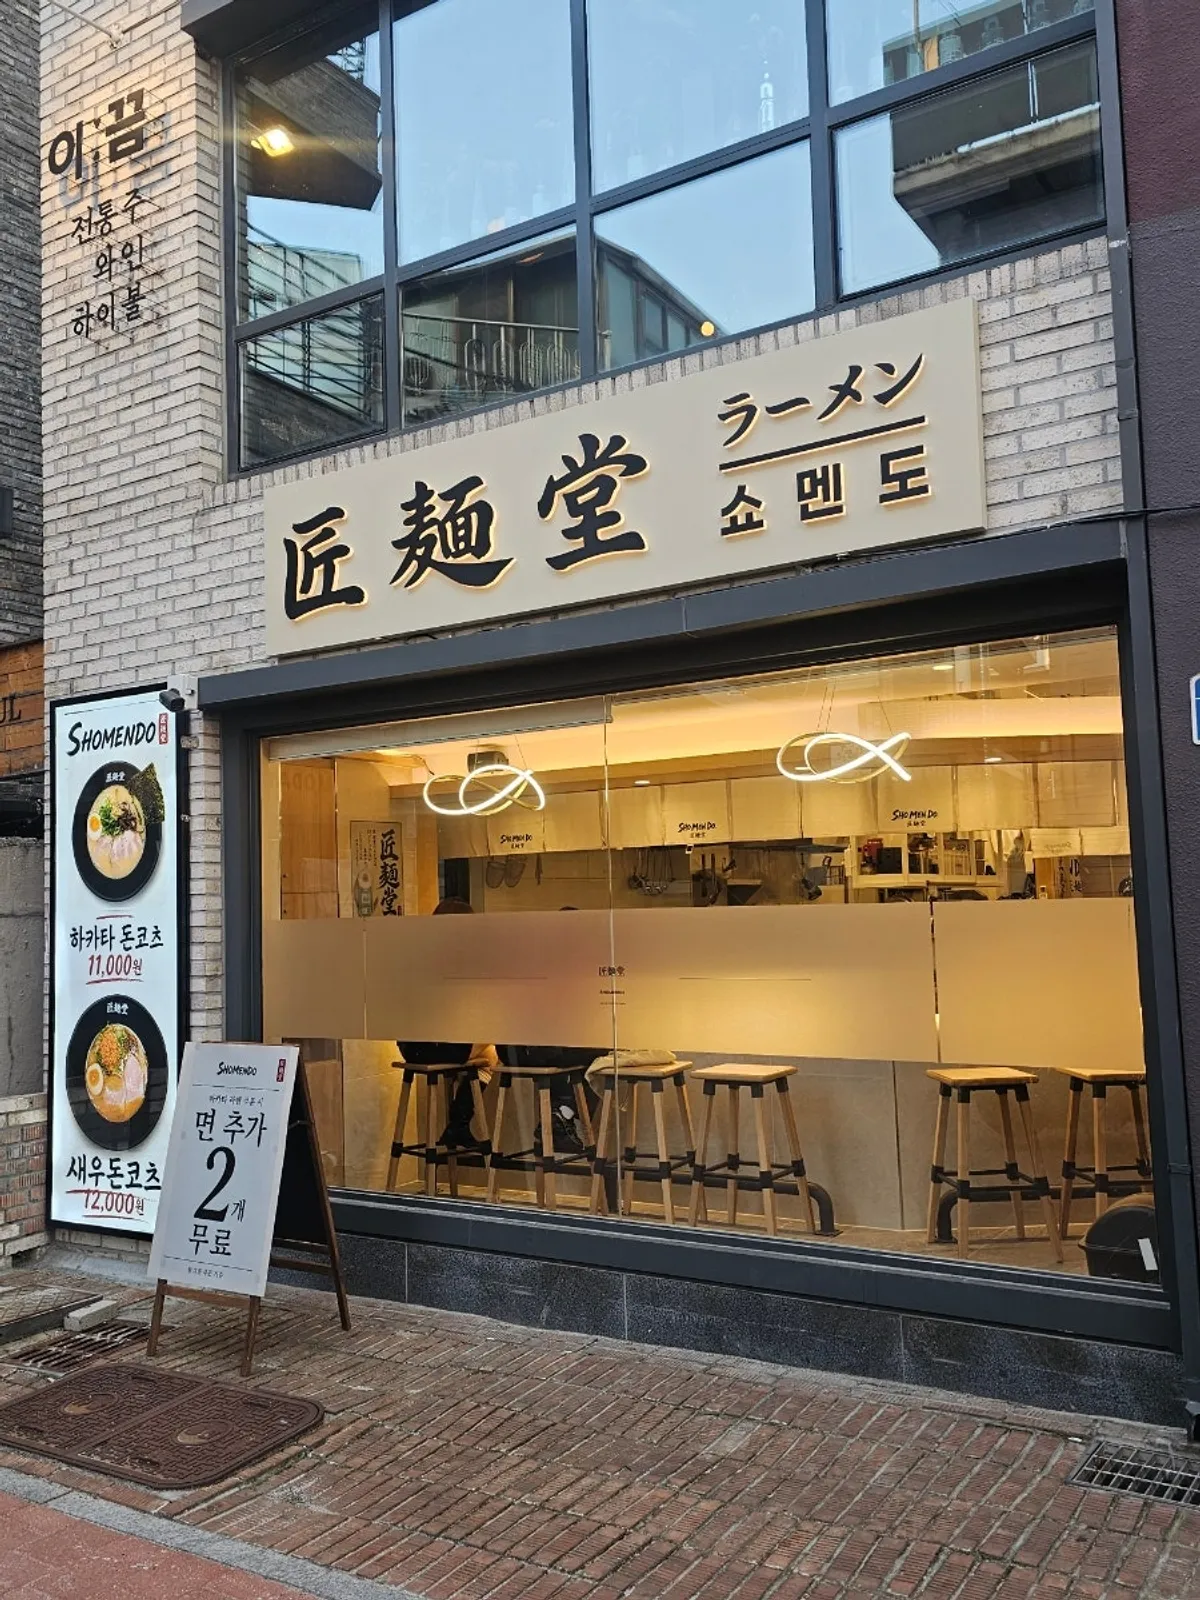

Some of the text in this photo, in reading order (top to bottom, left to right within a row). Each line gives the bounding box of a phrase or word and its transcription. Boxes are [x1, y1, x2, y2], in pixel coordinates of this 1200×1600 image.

[71, 188, 149, 245] 전통주
[92, 234, 143, 282] 와인
[71, 281, 146, 338] 하이볼
[717, 353, 925, 447] ラーメン
[720, 444, 931, 537] 쇼멘도
[67, 721, 156, 756] SHOMENDO
[70, 924, 164, 952] 하카타 돈코츠
[88, 954, 142, 978] 11,000원
[217, 1061, 257, 1076] SHOMENDO
[196, 1108, 267, 1148] 면 추가
[84, 1189, 144, 1215] 12,000원
[193, 1146, 246, 1223] 2개
[188, 1224, 232, 1256] 무료
